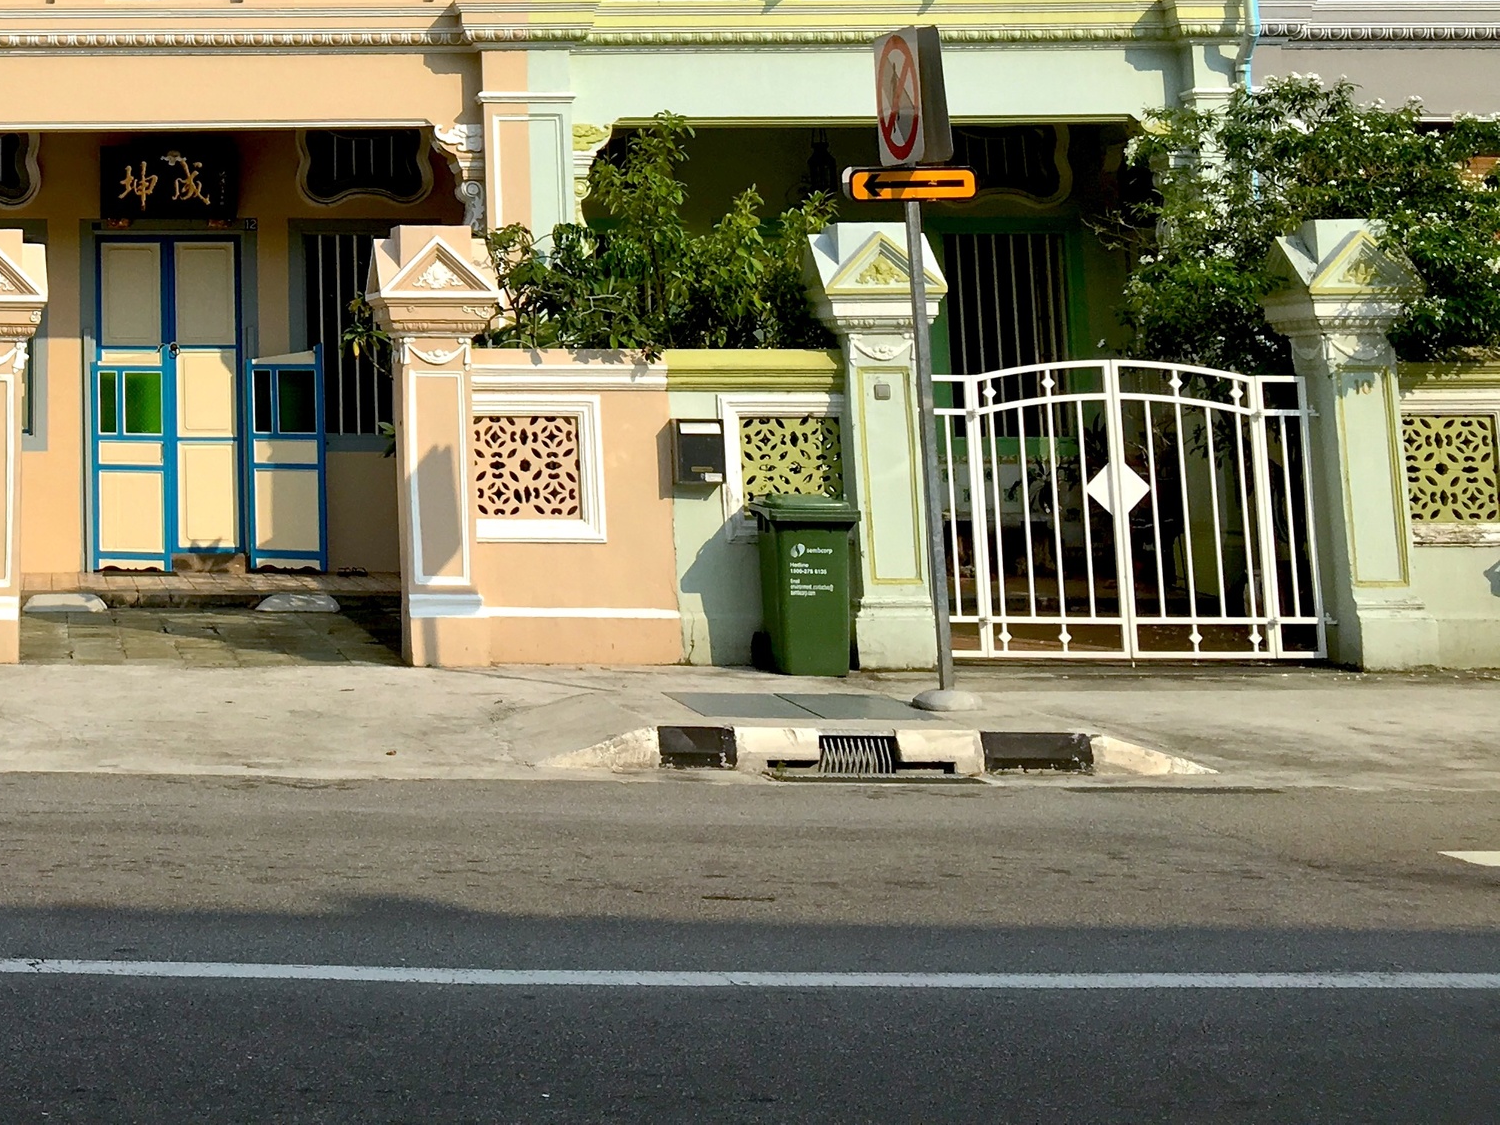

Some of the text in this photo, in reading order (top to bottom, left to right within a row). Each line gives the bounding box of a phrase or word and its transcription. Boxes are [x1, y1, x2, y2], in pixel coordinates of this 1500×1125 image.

[245, 219, 257, 230] 12
[1353, 378, 1372, 395] 10
[806, 547, 833, 555] sembcorp
